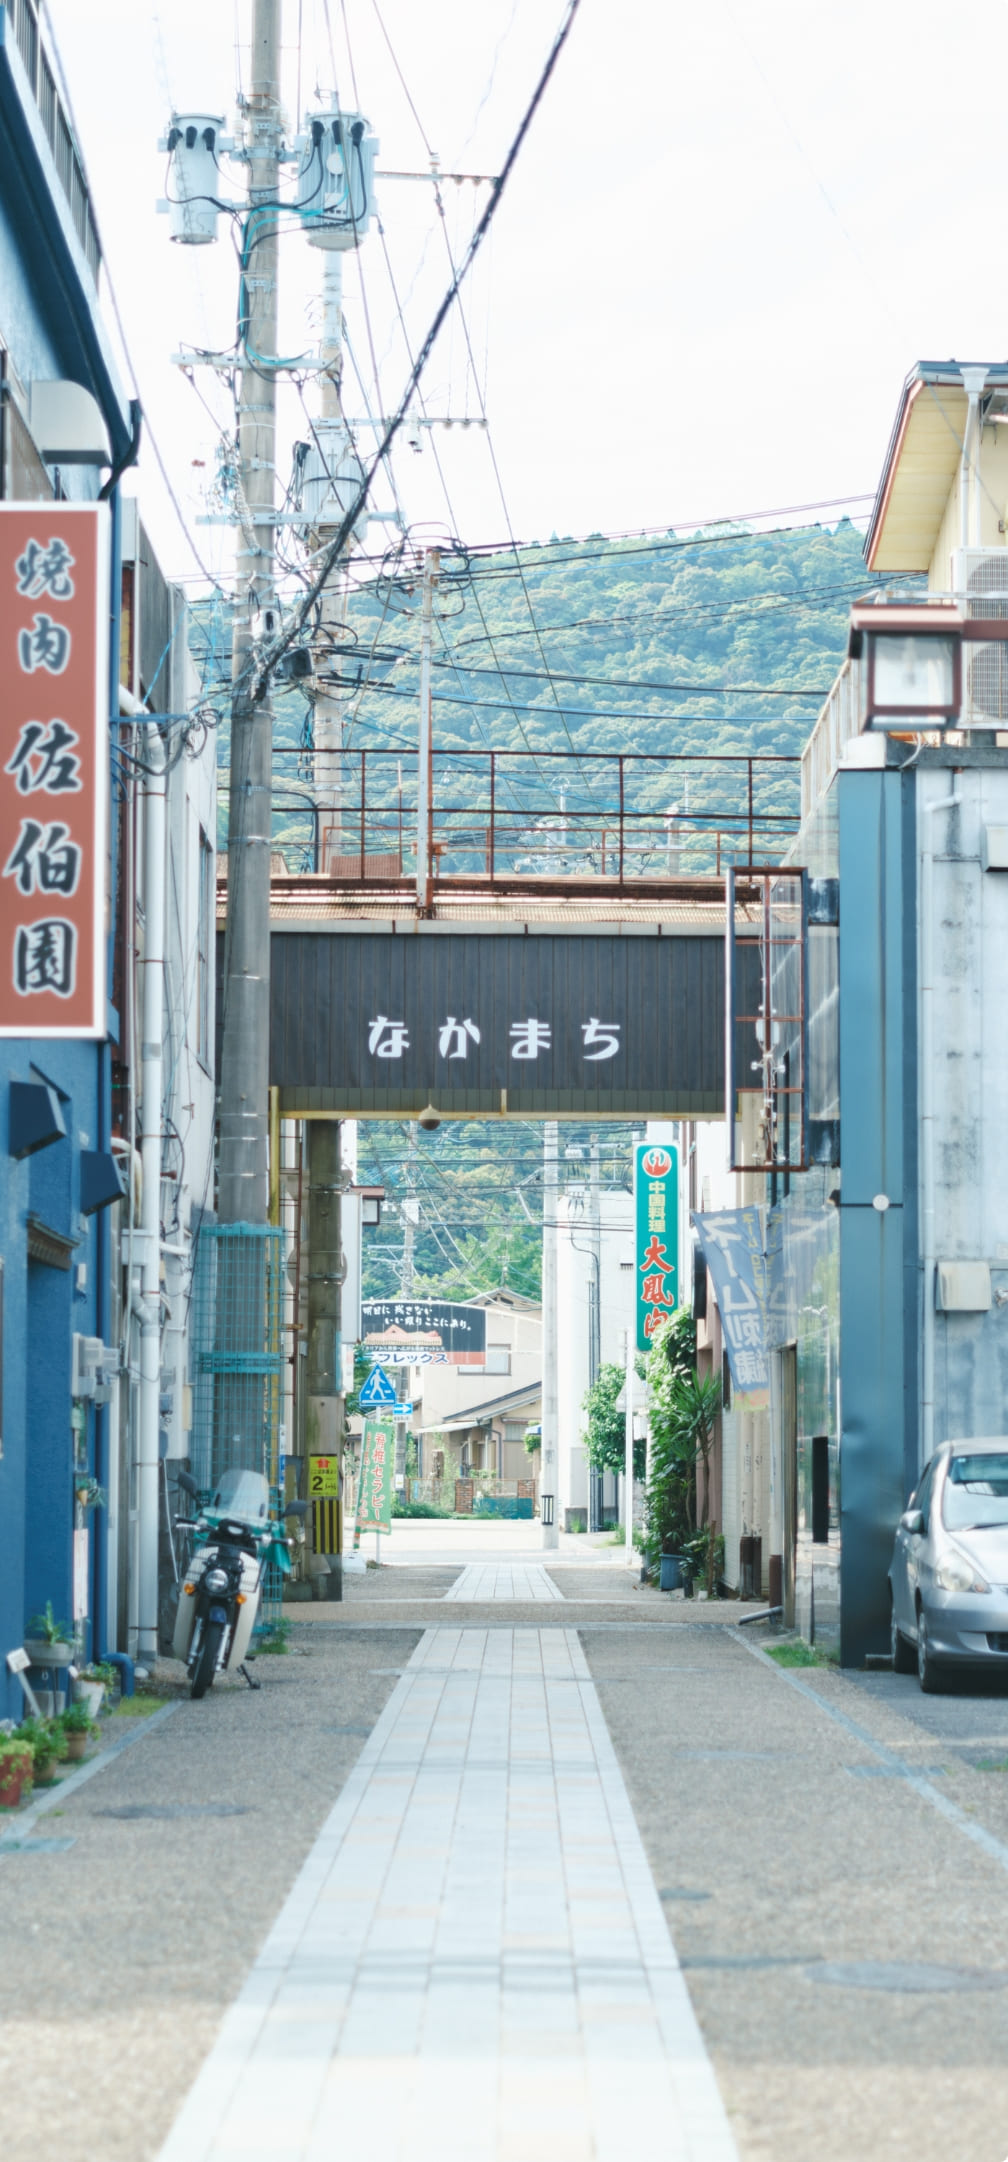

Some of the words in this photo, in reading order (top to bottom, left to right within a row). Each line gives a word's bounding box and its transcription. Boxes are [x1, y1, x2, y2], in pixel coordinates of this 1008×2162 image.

[15, 537, 75, 674] 焼肉
[2, 719, 83, 998] 佐伯園
[368, 1015, 621, 1061] なかまち
[648, 1180, 666, 1233] 中国料理
[312, 1475, 323, 1491] 2
